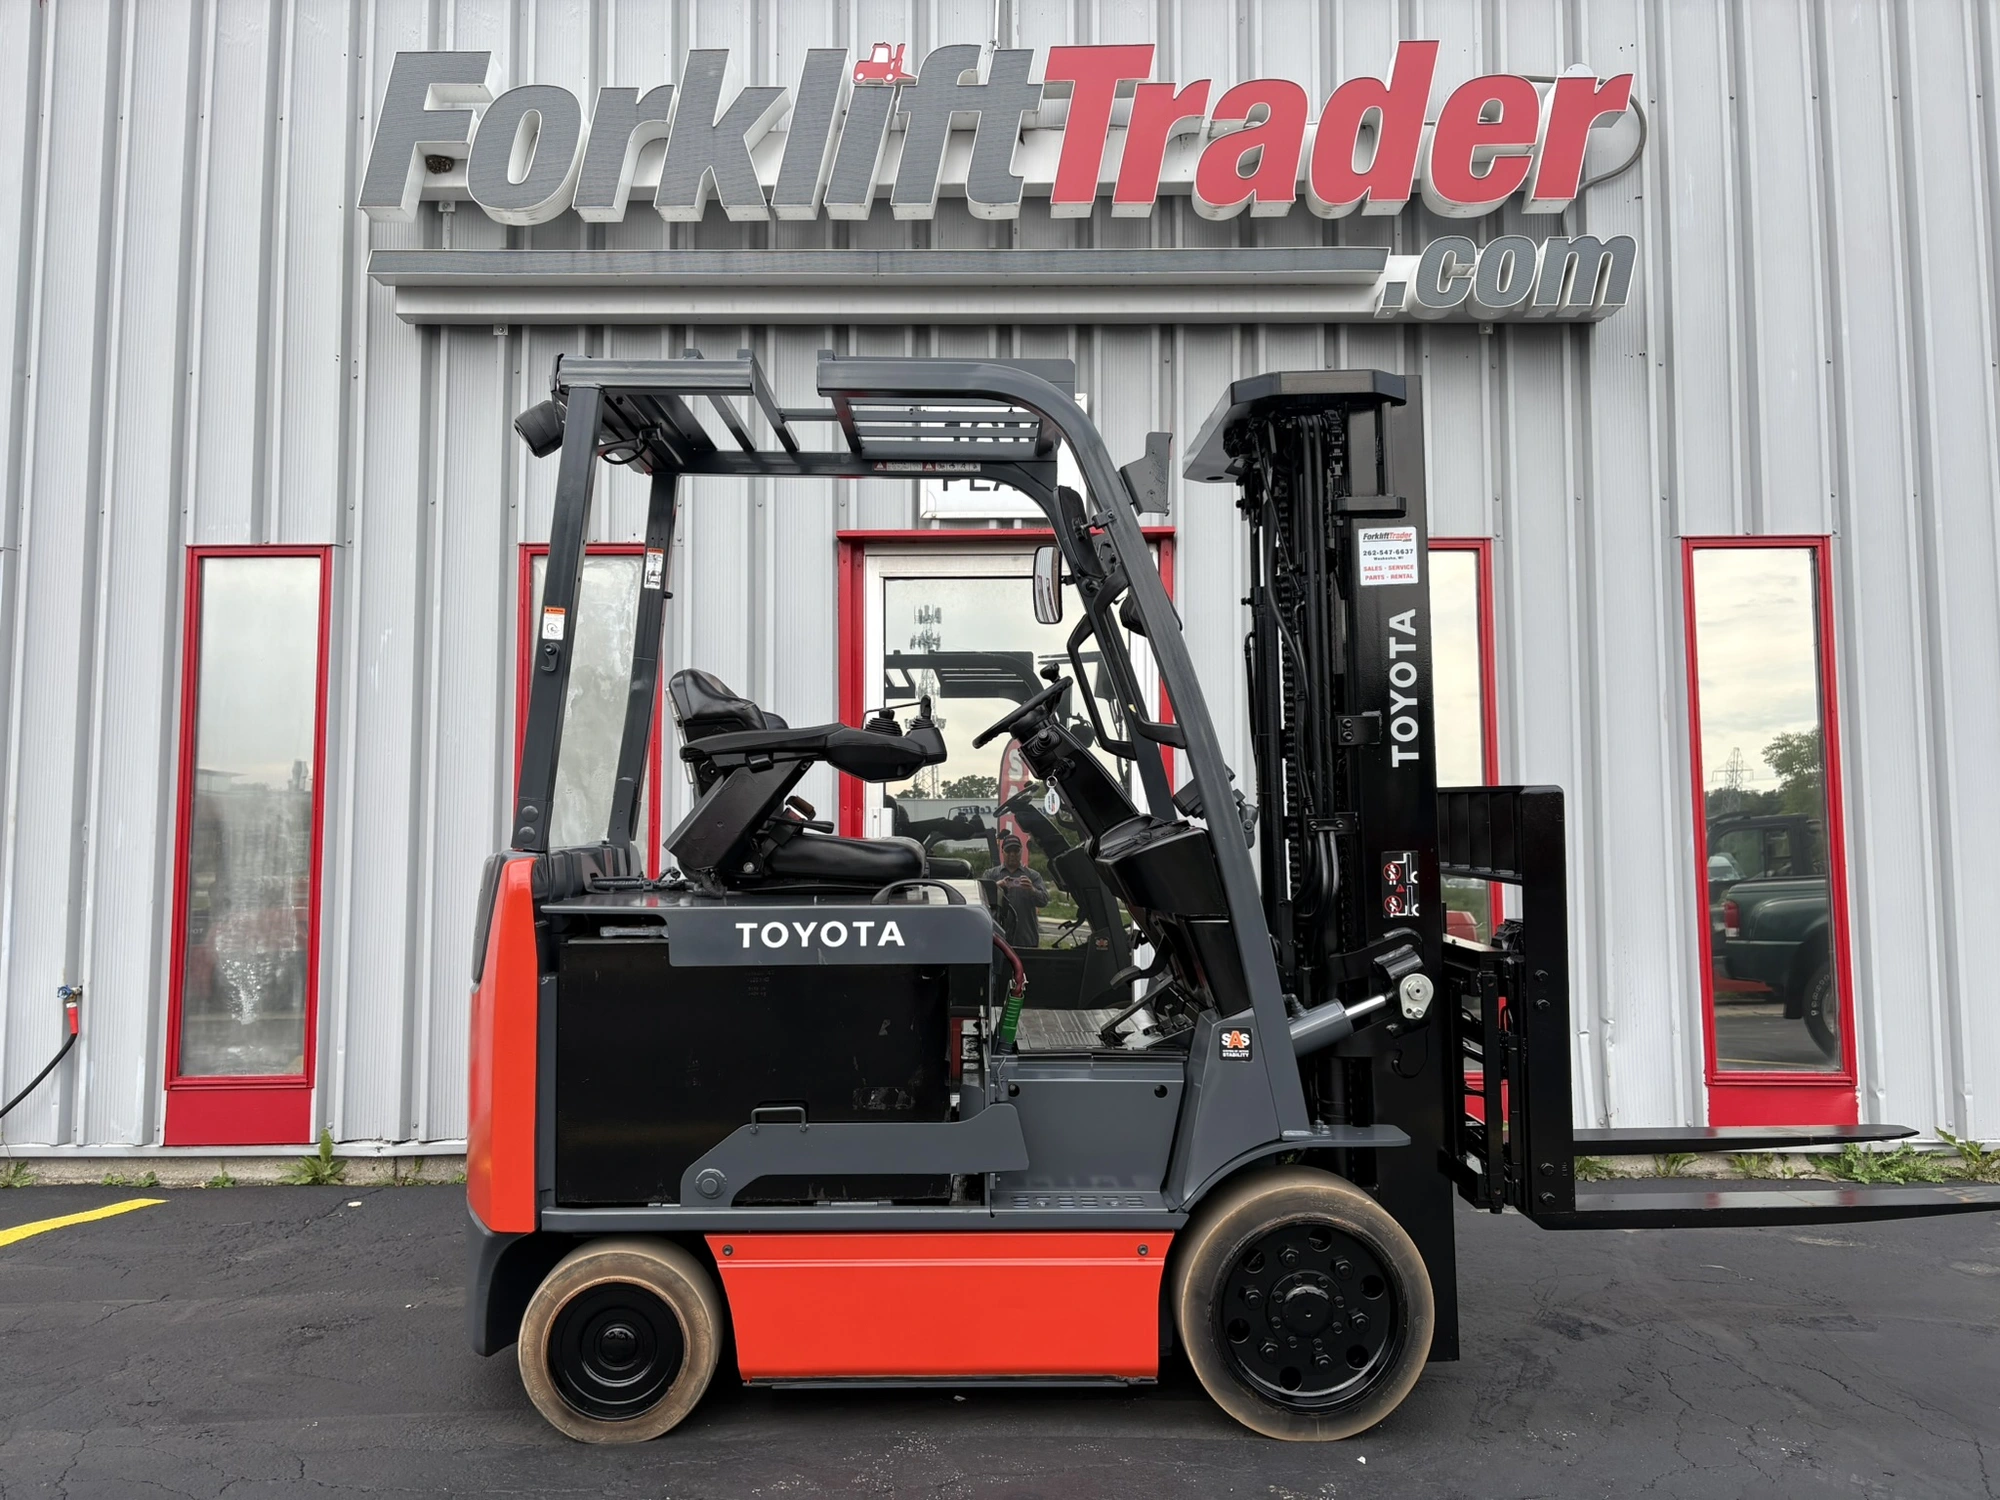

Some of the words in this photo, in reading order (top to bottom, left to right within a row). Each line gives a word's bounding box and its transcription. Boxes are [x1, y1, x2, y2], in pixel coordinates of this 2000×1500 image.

[358, 39, 1635, 216] ForkliftTrader
[1377, 235, 1637, 313] .com
[1389, 608, 1420, 768] TOYOTA
[735, 921, 905, 948] TOYOTA
[1221, 1030, 1250, 1048] SAS
